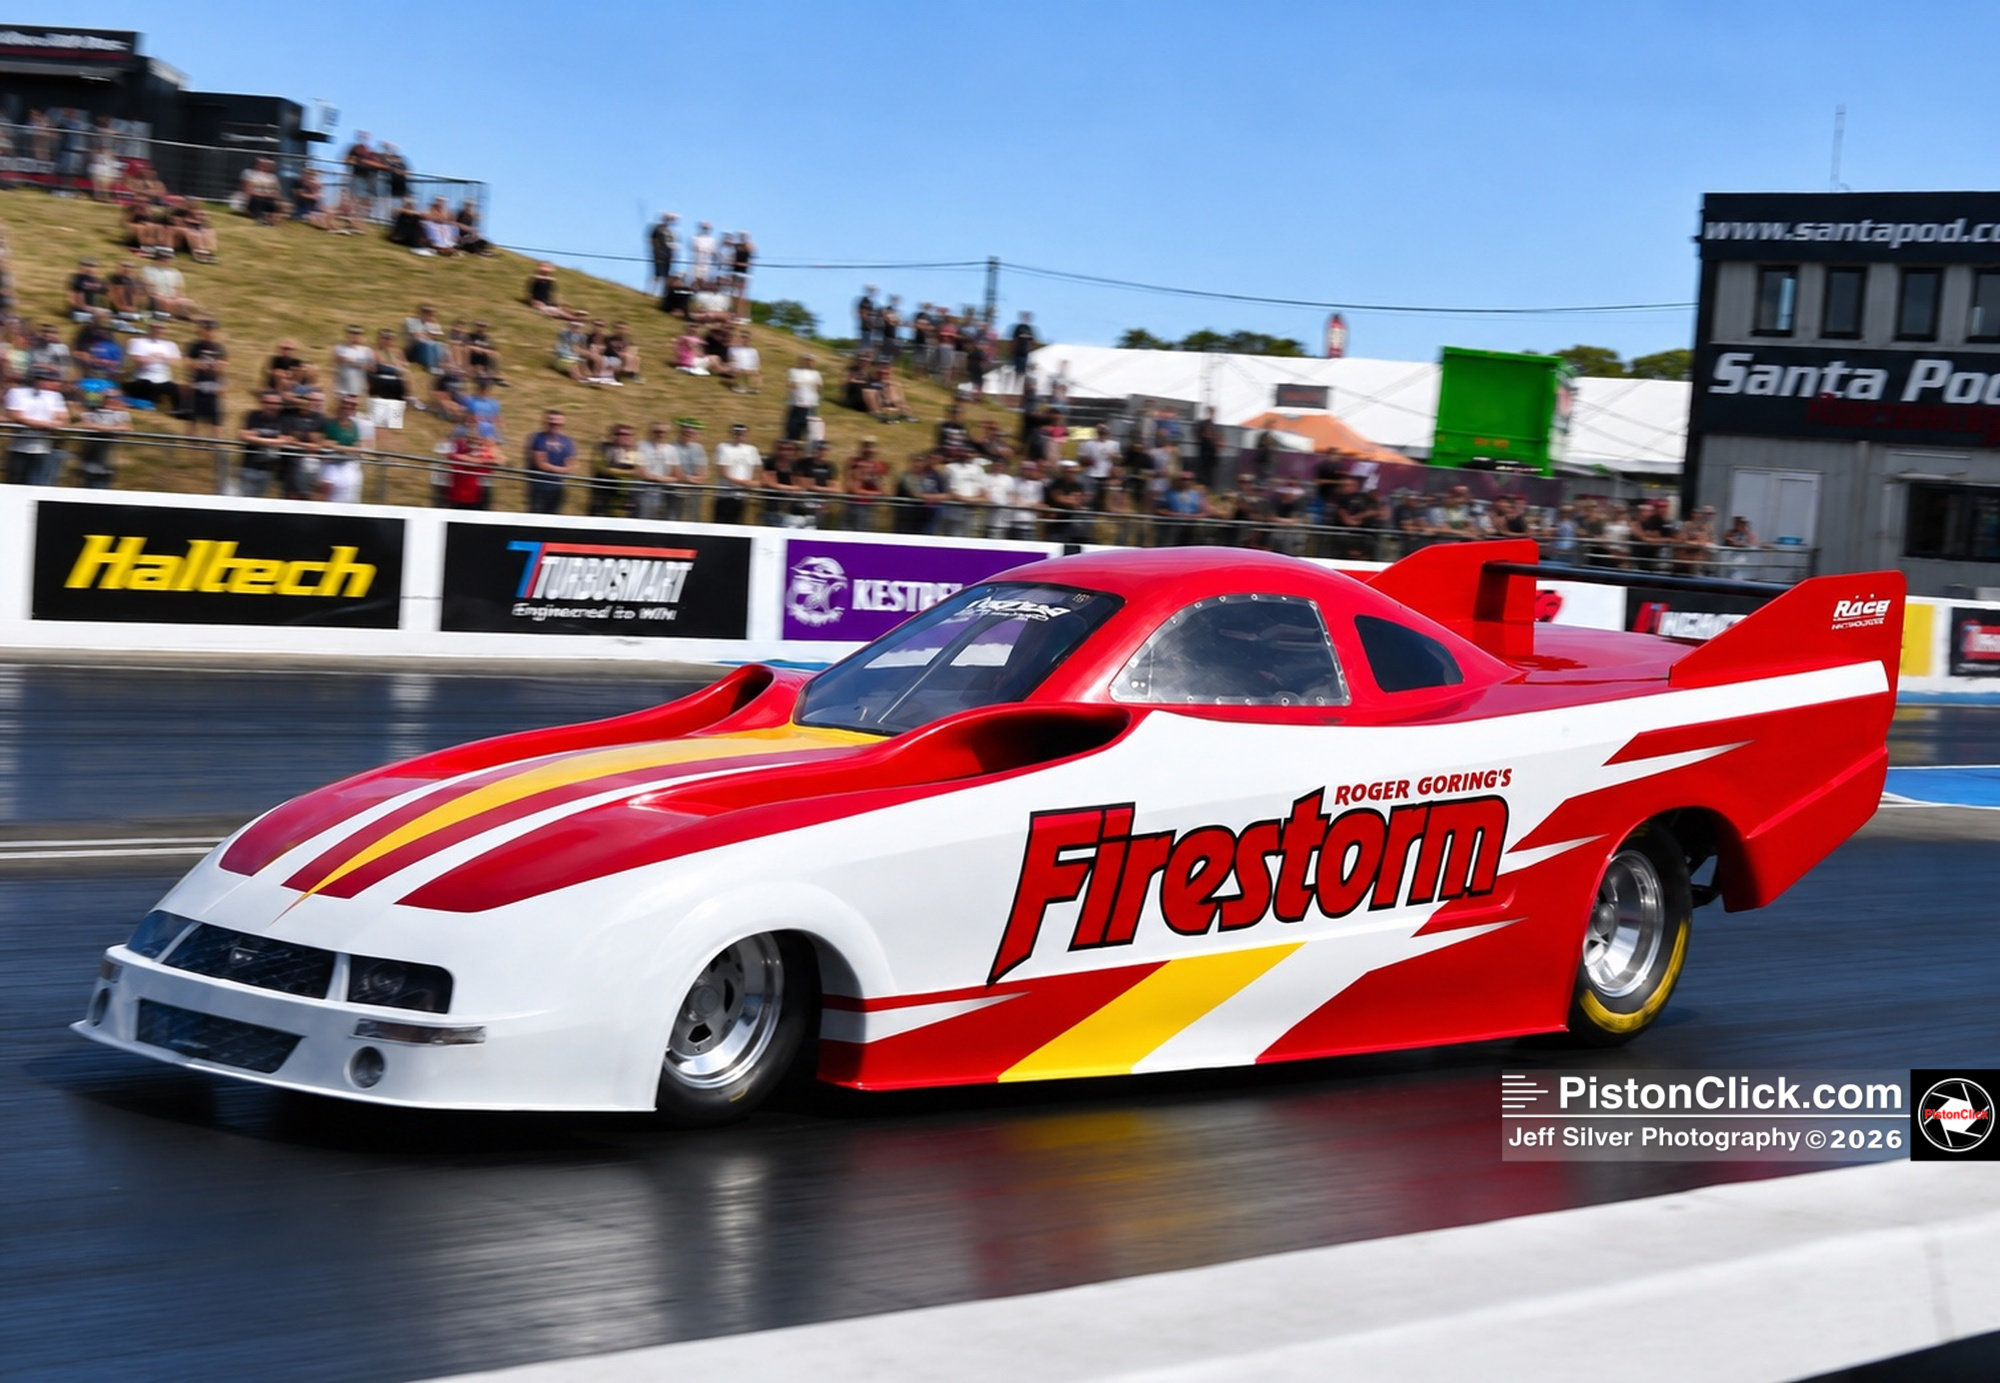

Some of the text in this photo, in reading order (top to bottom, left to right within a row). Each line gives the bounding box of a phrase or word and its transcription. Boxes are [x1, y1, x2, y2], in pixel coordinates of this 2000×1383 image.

[1708, 352, 1887, 400] Santa
[63, 535, 377, 598] Haltech
[511, 602, 611, 622] Engineered
[612, 605, 636, 620] to
[1334, 767, 1513, 805] ROGER GORING'S
[986, 786, 1510, 986] Firestorm
